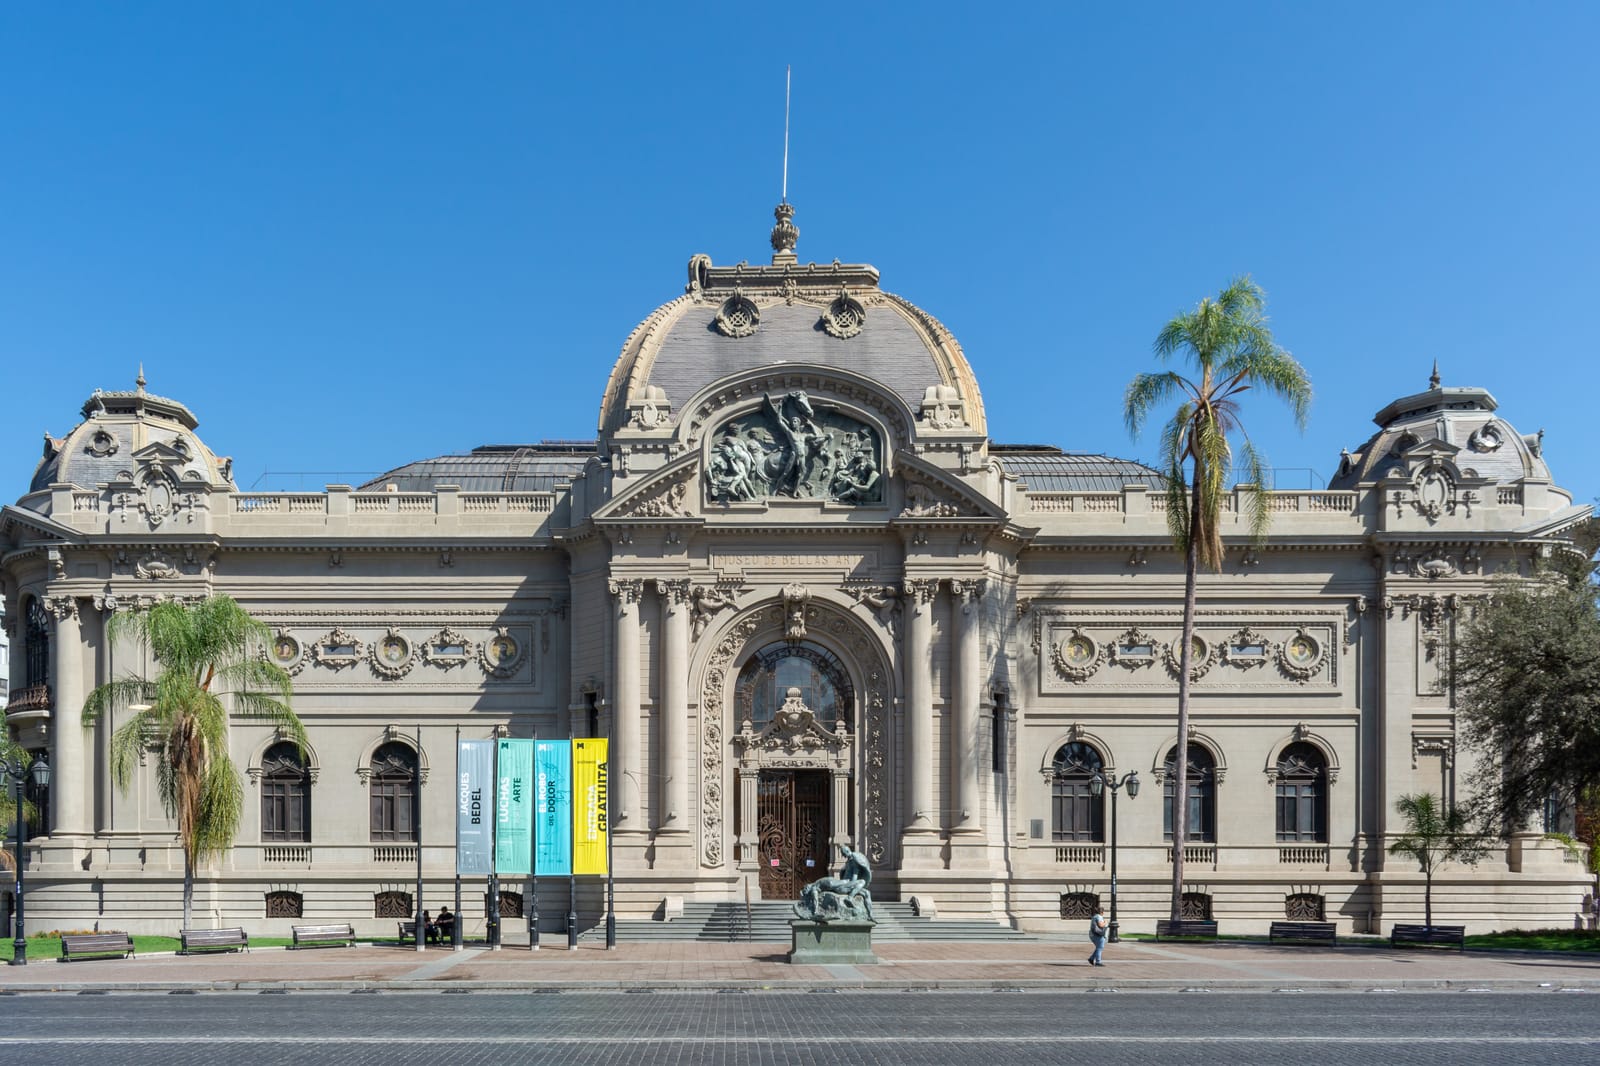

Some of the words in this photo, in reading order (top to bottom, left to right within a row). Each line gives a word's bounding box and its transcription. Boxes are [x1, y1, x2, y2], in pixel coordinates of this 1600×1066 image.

[718, 555, 758, 565] MUSEO
[765, 555, 777, 565] DE
[782, 555, 829, 565] BELLAS
[836, 555, 874, 566] ARTS
[460, 772, 470, 816] JACQUES
[499, 777, 510, 823] LUCHAS
[512, 777, 522, 803] ARTE
[538, 773, 547, 801] ROBO
[547, 780, 556, 813] DOLOR
[597, 762, 608, 832] GRATUITA
[471, 788, 481, 825] BEDEL
[538, 803, 547, 813] EL
[587, 784, 597, 840] ENTRADA
